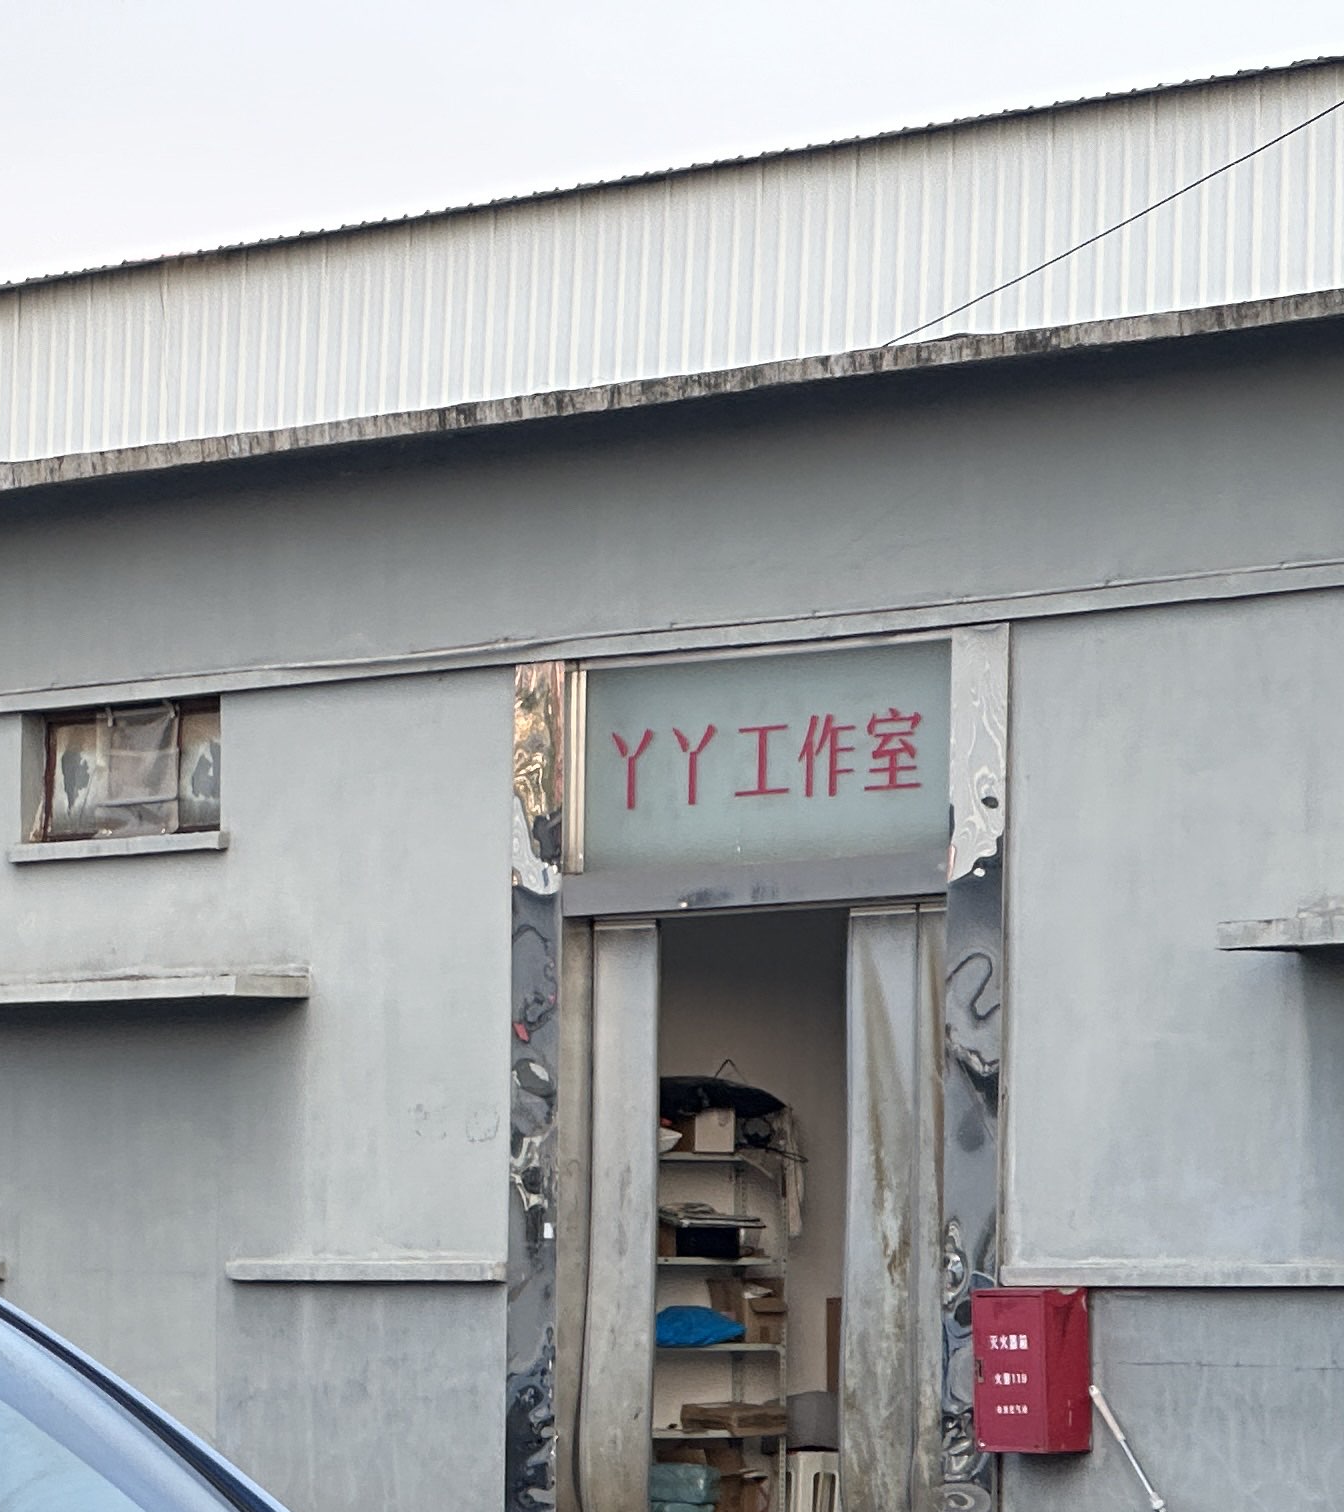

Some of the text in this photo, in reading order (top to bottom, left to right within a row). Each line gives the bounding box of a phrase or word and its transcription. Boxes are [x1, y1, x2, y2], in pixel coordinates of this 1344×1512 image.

[612, 707, 923, 811] 丫丫工作室
